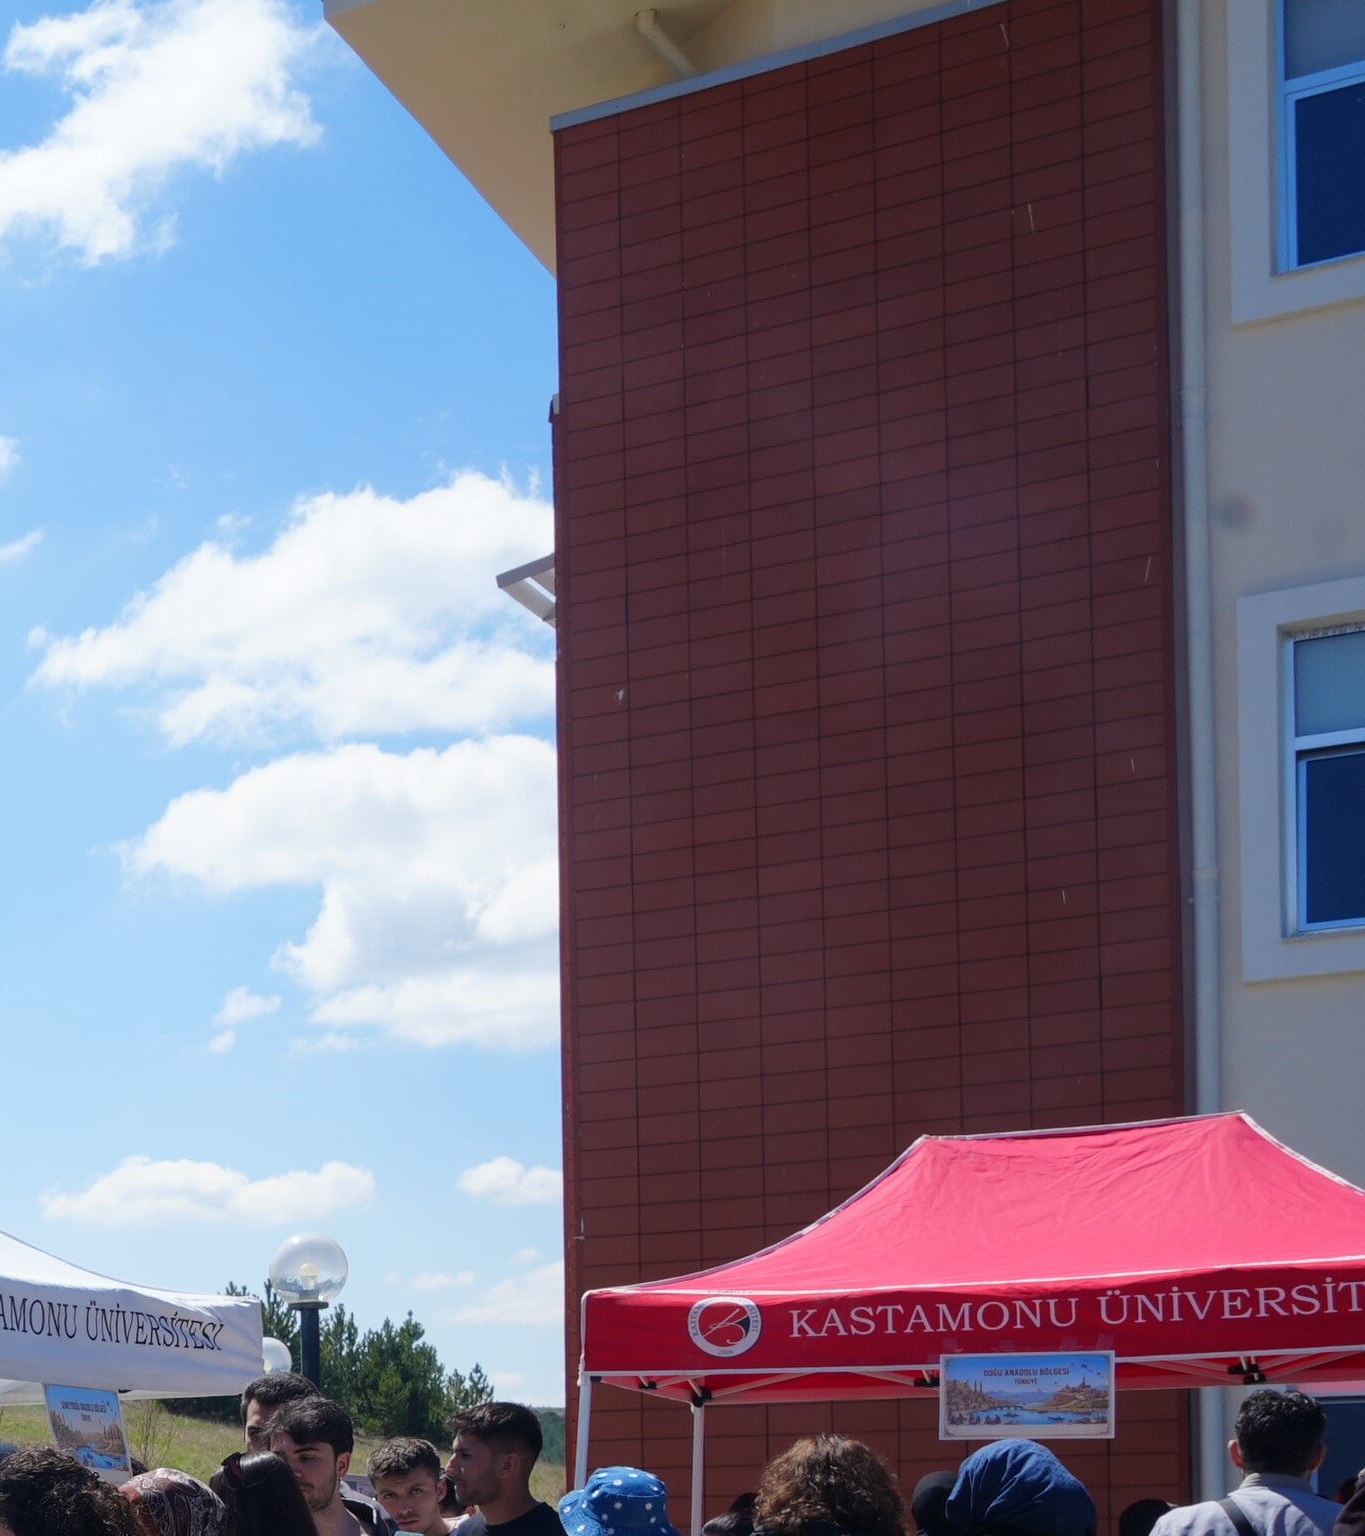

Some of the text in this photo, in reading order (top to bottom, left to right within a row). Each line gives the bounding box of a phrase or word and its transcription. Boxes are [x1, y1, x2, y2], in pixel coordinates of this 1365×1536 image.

[85, 1300, 225, 1351] ÜNİVERSİTESİ
[789, 1276, 1365, 1338] KASTAMONU ÜNİVERSİT
[1004, 1368, 1038, 1377] ANADOLU
